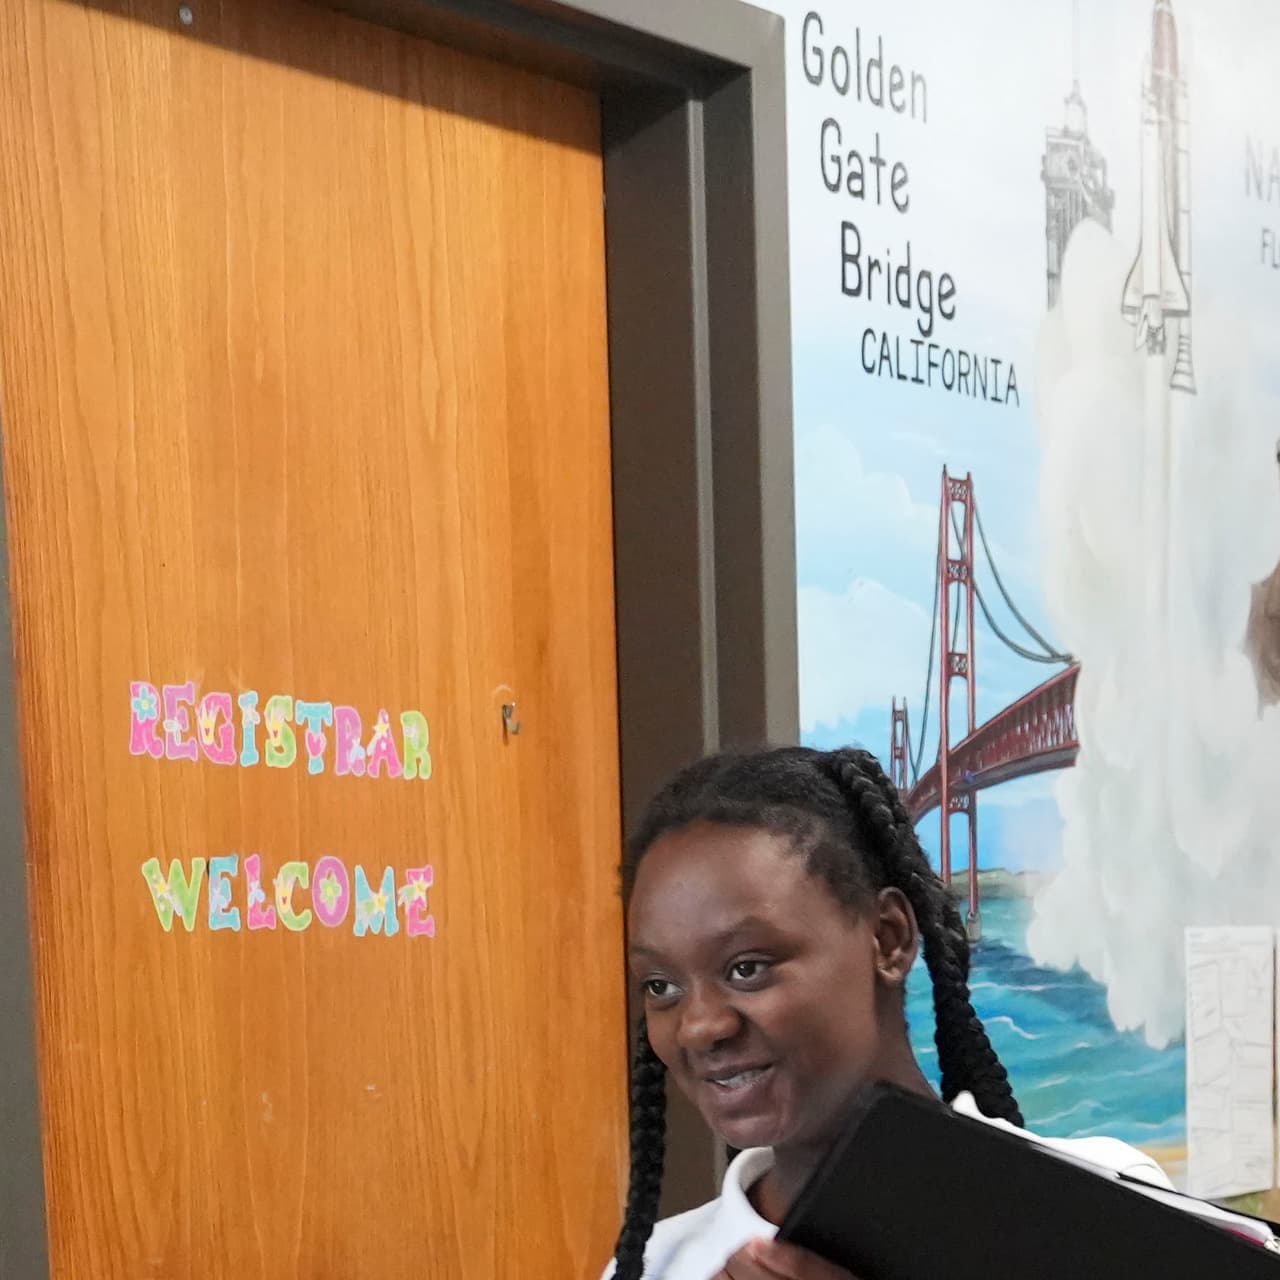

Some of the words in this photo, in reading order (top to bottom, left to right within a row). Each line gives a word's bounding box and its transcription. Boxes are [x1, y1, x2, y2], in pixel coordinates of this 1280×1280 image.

[801, 10, 929, 123] Golden
[819, 116, 911, 214] Gate
[839, 219, 958, 338] Bridge
[860, 327, 1021, 408] CALIFORNIA
[128, 680, 433, 780] REGISTRAR
[140, 853, 437, 938] WELCOME
